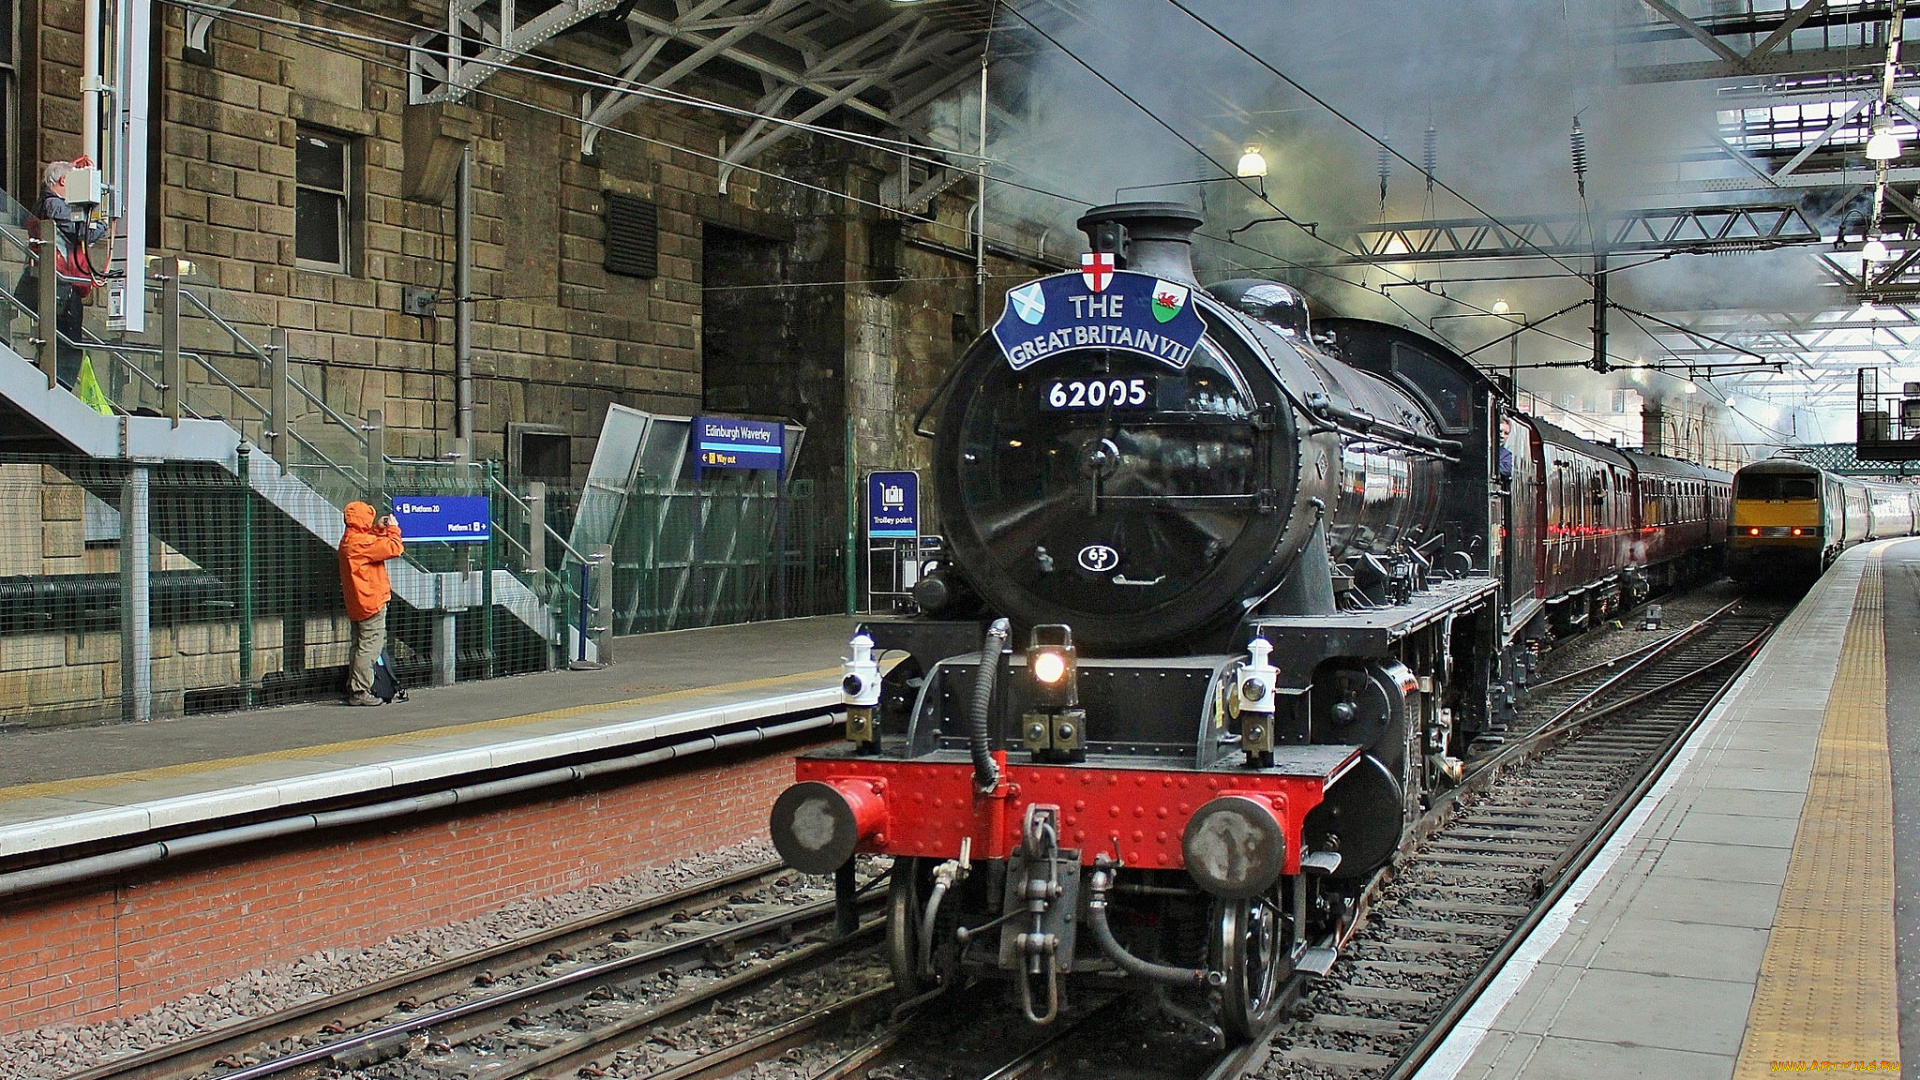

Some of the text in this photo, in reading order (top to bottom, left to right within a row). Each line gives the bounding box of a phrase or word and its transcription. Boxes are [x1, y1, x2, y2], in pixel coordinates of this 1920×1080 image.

[1069, 294, 1124, 319] THE
[1009, 325, 1191, 366] GREAT BRITAIN VII
[1049, 379, 1147, 408] 62005
[705, 424, 771, 442] Edinburgh Waverley
[716, 454, 736, 465] Way out
[411, 505, 440, 513] Platform 20
[873, 516, 913, 525] Trolley point
[447, 523, 469, 532] Platform
[1088, 548, 1108, 561] 65
